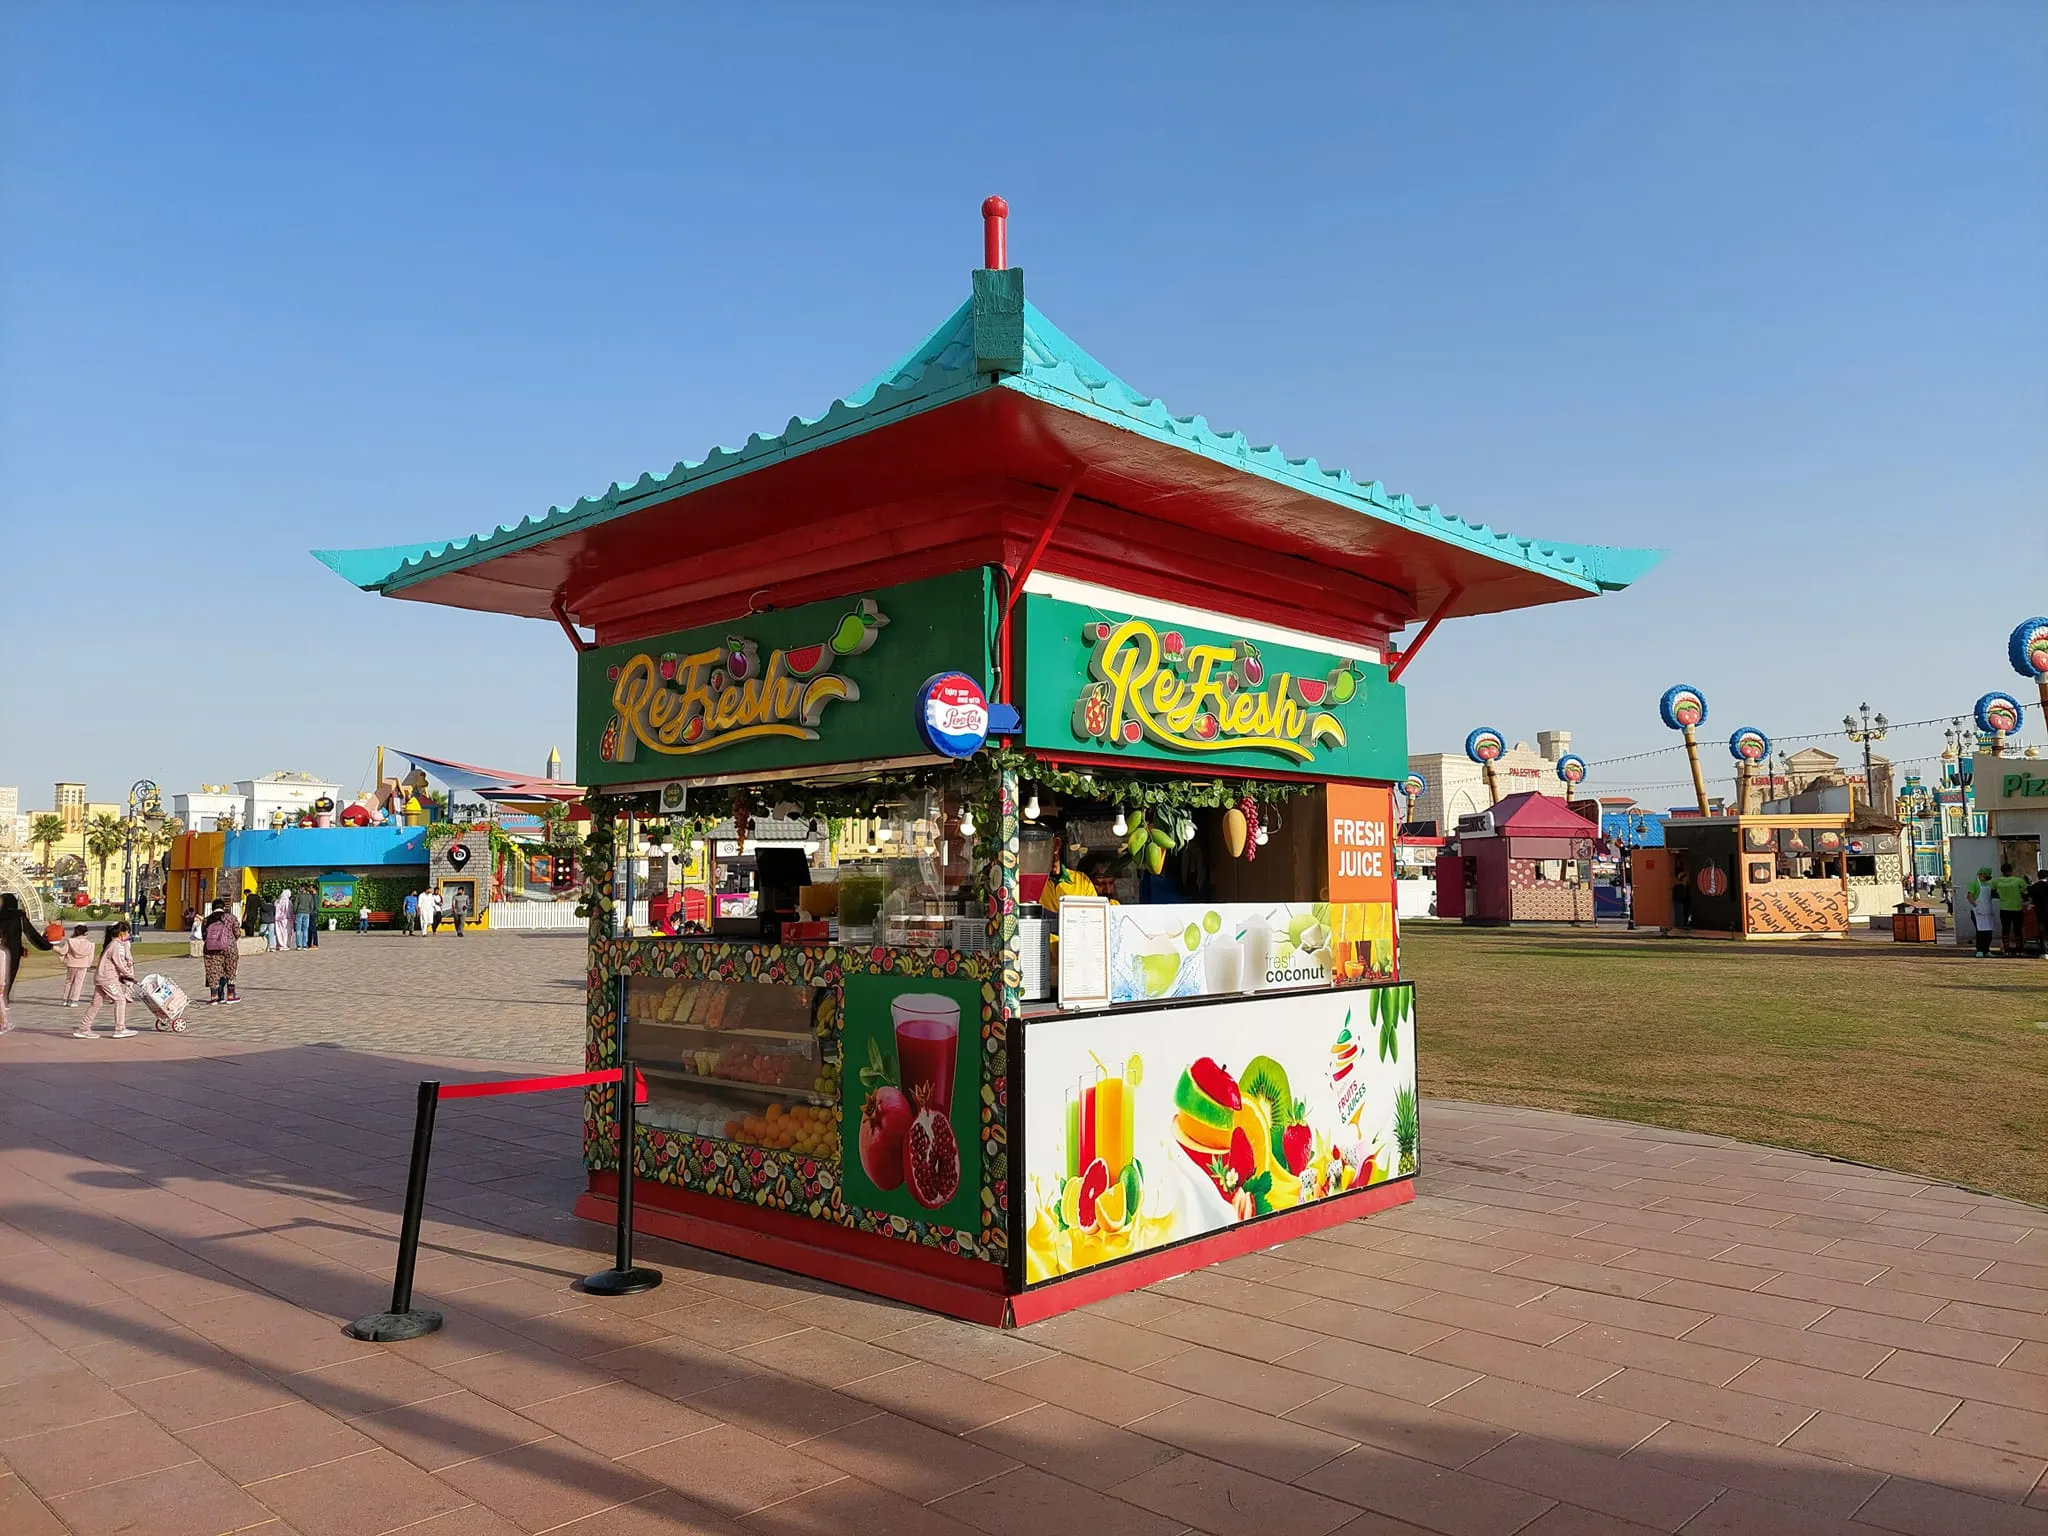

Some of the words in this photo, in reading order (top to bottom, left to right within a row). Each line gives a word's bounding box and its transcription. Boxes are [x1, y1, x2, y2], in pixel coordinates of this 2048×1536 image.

[2003, 772, 2048, 797] Piz
[1333, 818, 1385, 847] FRESH
[1338, 850, 1383, 877] JUICE
[1265, 952, 1296, 970] fresh
[1265, 964, 1325, 983] coconut
[1337, 1080, 1358, 1113] FRUITS
[1341, 1112, 1347, 1124] &
[1347, 1083, 1367, 1116] JUICES
